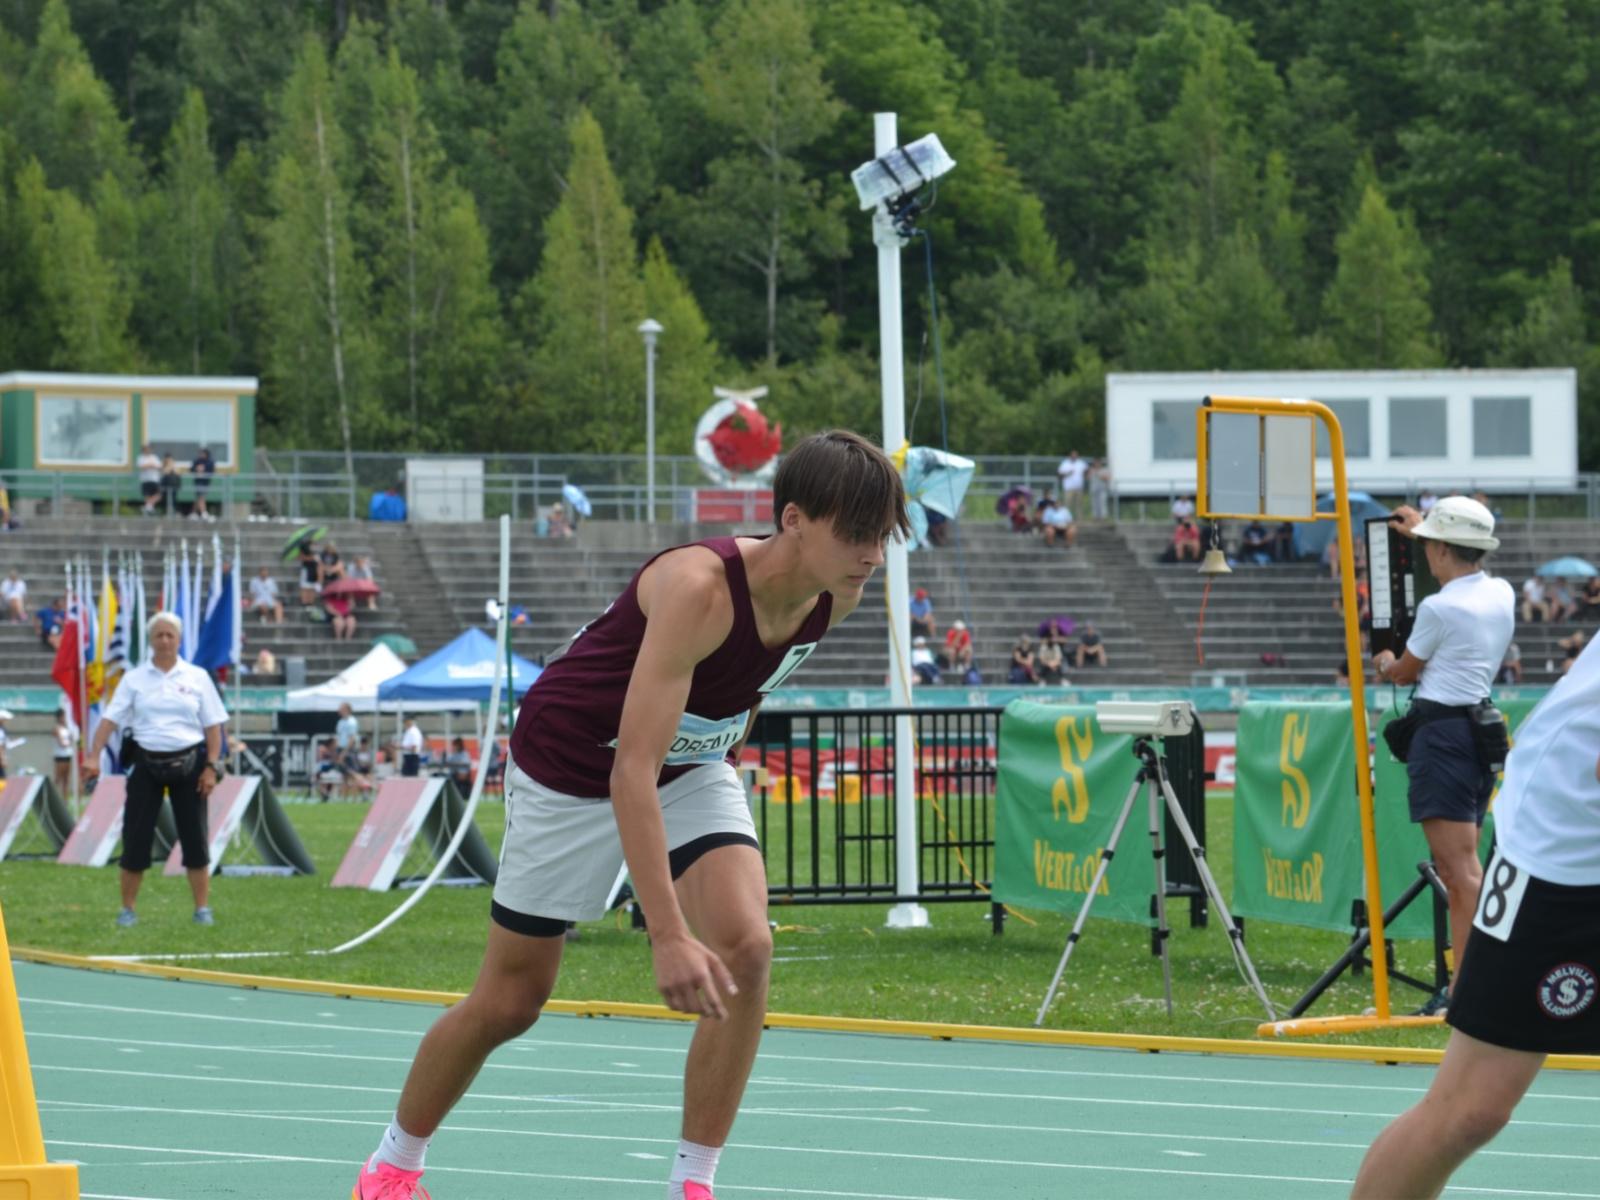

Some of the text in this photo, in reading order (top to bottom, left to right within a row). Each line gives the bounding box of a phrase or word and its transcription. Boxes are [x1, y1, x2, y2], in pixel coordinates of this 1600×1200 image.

[769, 646, 811, 690] 7
[1482, 856, 1518, 928] 8
[1546, 965, 1595, 986] MELVILLE
